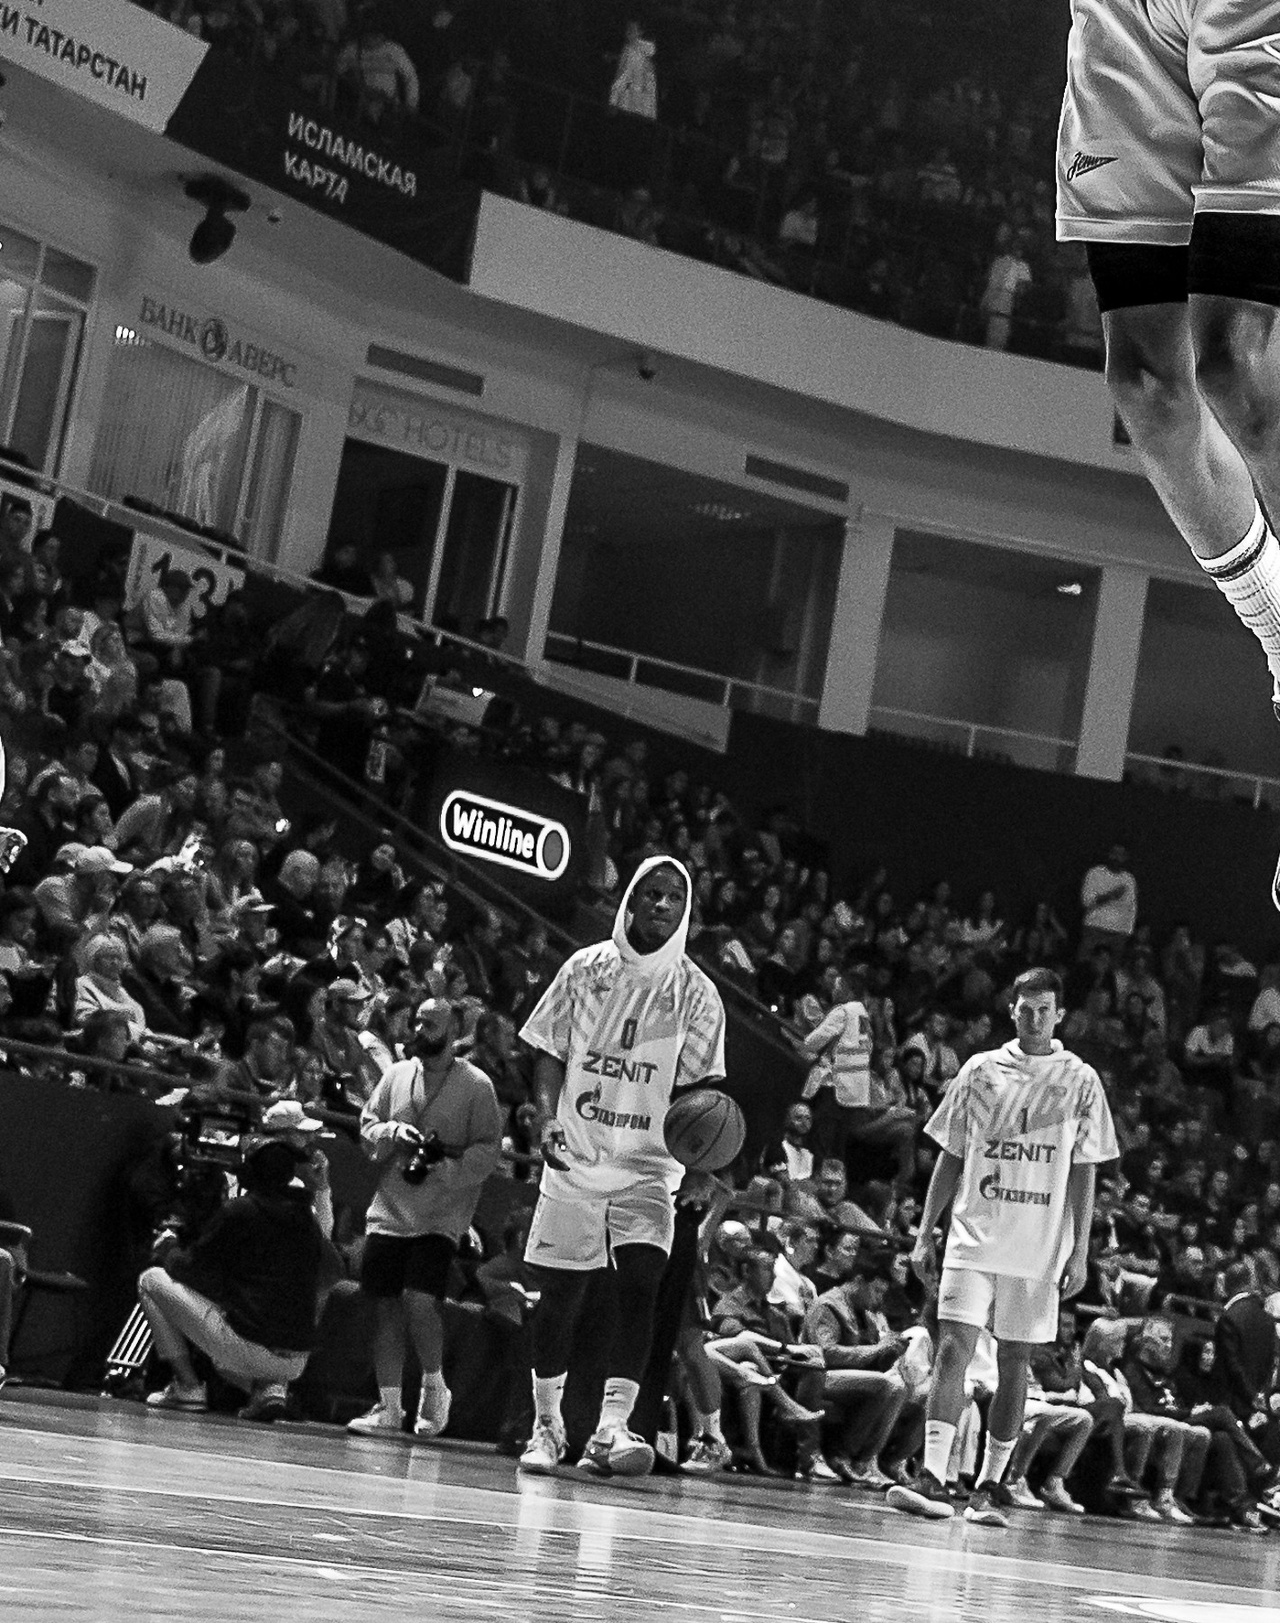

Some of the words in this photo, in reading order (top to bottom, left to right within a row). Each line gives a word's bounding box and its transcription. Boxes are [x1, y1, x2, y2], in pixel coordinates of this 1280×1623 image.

[25, 16, 147, 101] ТАТАРСТАН
[285, 150, 349, 203] КАРТА
[288, 111, 418, 197] ИСЛАМСКАЯ
[140, 297, 198, 344] БАНК
[228, 341, 297, 388] АВЕРС
[404, 414, 512, 470] HOTELS
[453, 803, 535, 858] Winline
[620, 1018, 638, 1050] 0
[582, 1050, 658, 1084] ZENIT
[984, 1139, 1056, 1163] ZENIT
